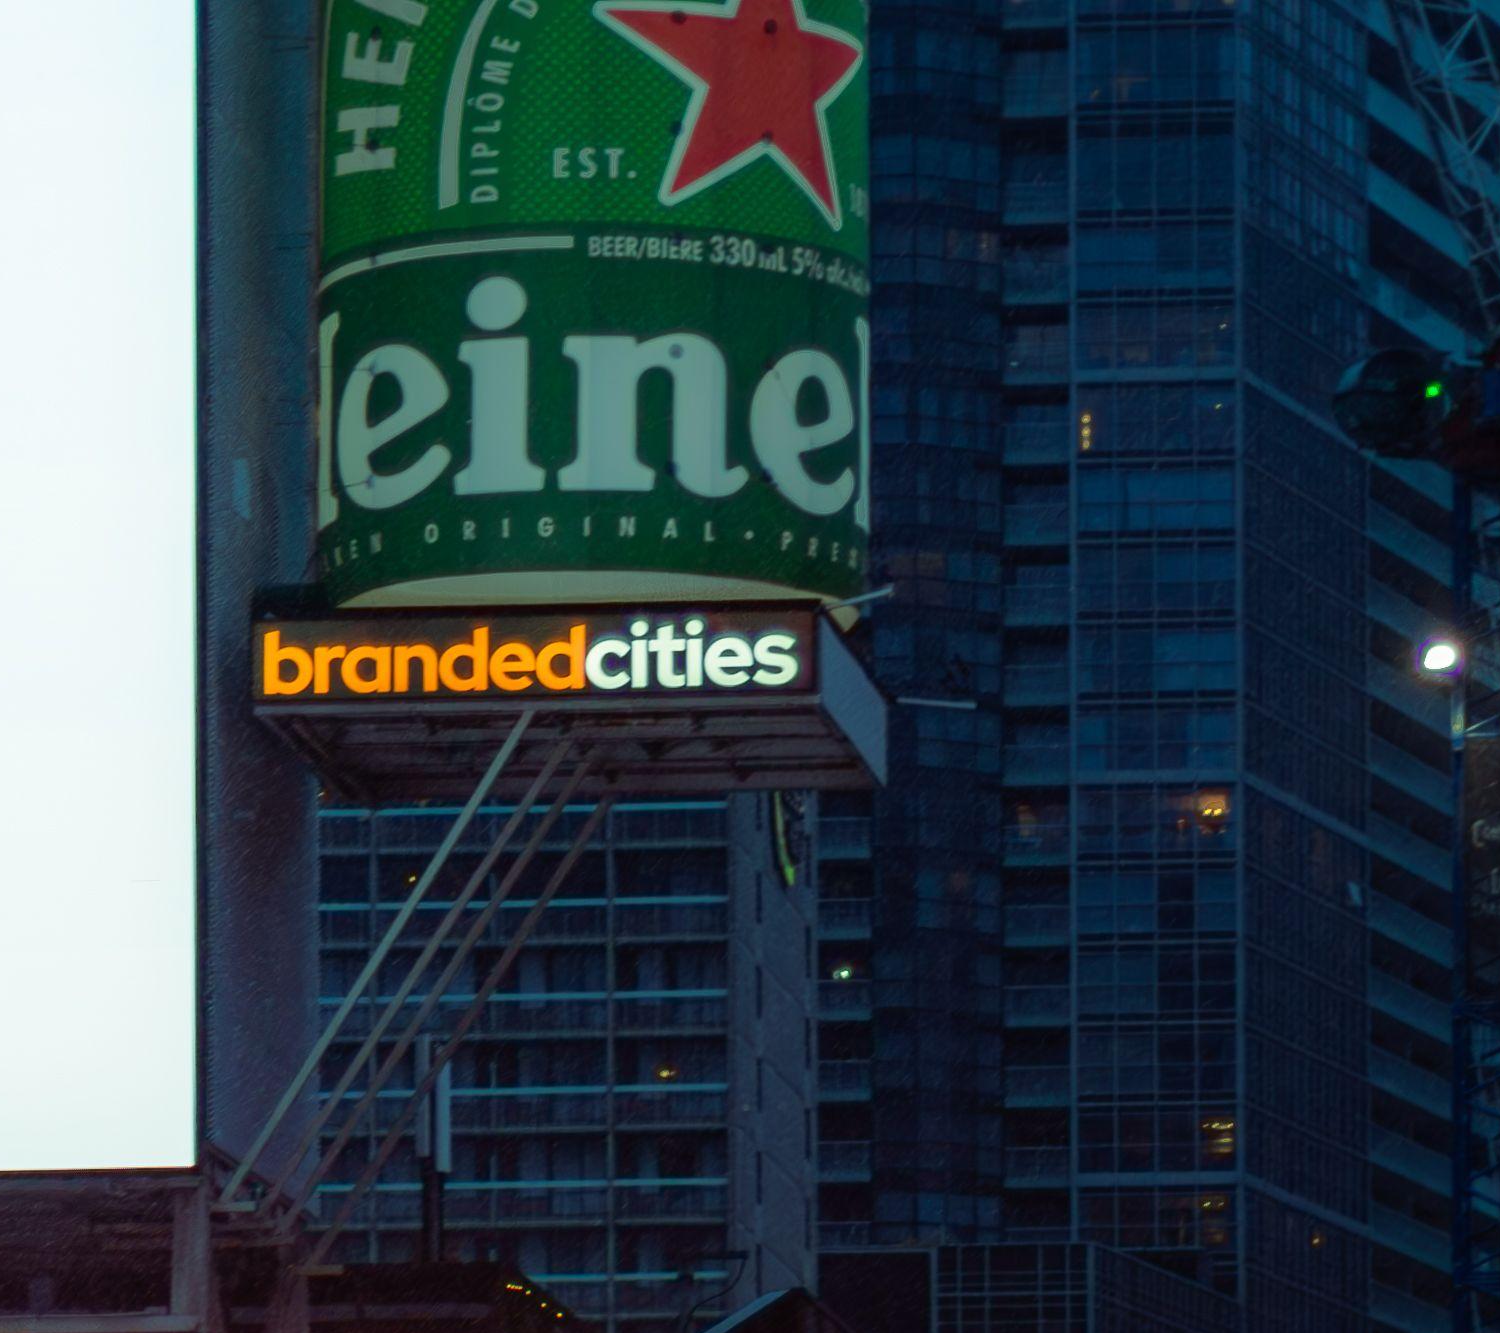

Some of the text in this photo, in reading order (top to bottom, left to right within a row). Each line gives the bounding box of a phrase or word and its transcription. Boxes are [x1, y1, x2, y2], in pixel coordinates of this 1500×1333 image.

[553, 147, 638, 181] EST.
[709, 235, 757, 267] 330
[424, 516, 717, 544] ORIGINAL
[262, 620, 798, 695] brandedcities
